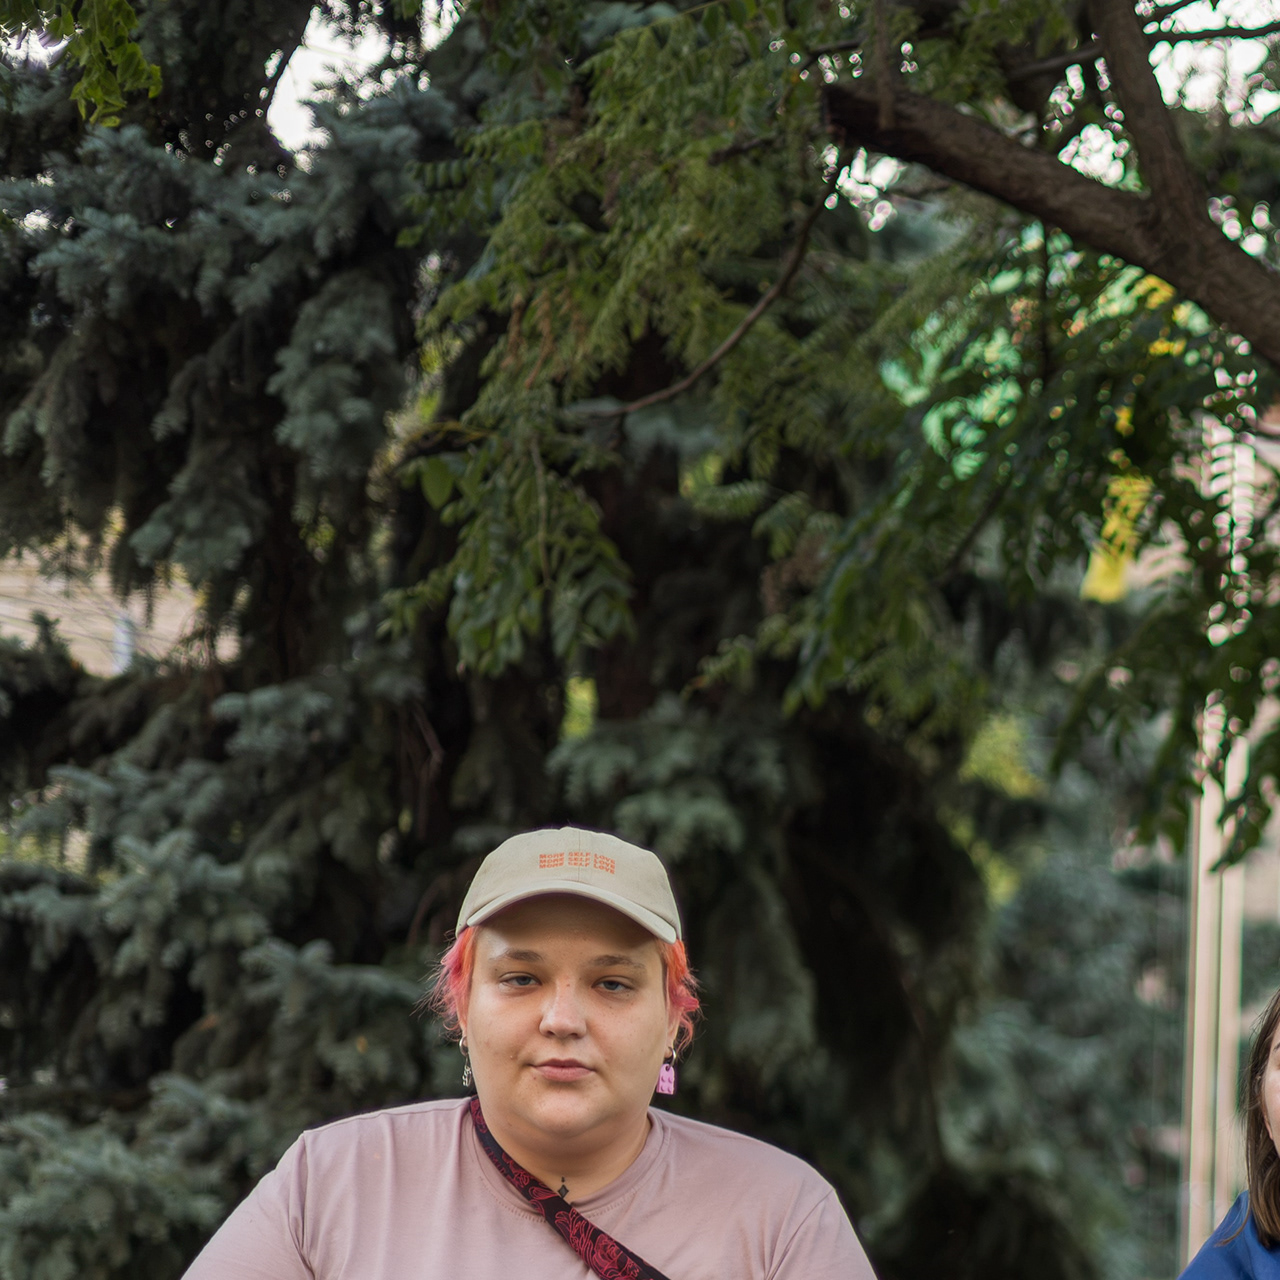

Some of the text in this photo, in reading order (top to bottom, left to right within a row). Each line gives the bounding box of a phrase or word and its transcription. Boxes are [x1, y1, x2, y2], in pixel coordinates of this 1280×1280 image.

[594, 853, 615, 864] LOVE
[594, 858, 615, 870] LOVE
[594, 863, 615, 875] LOVE
